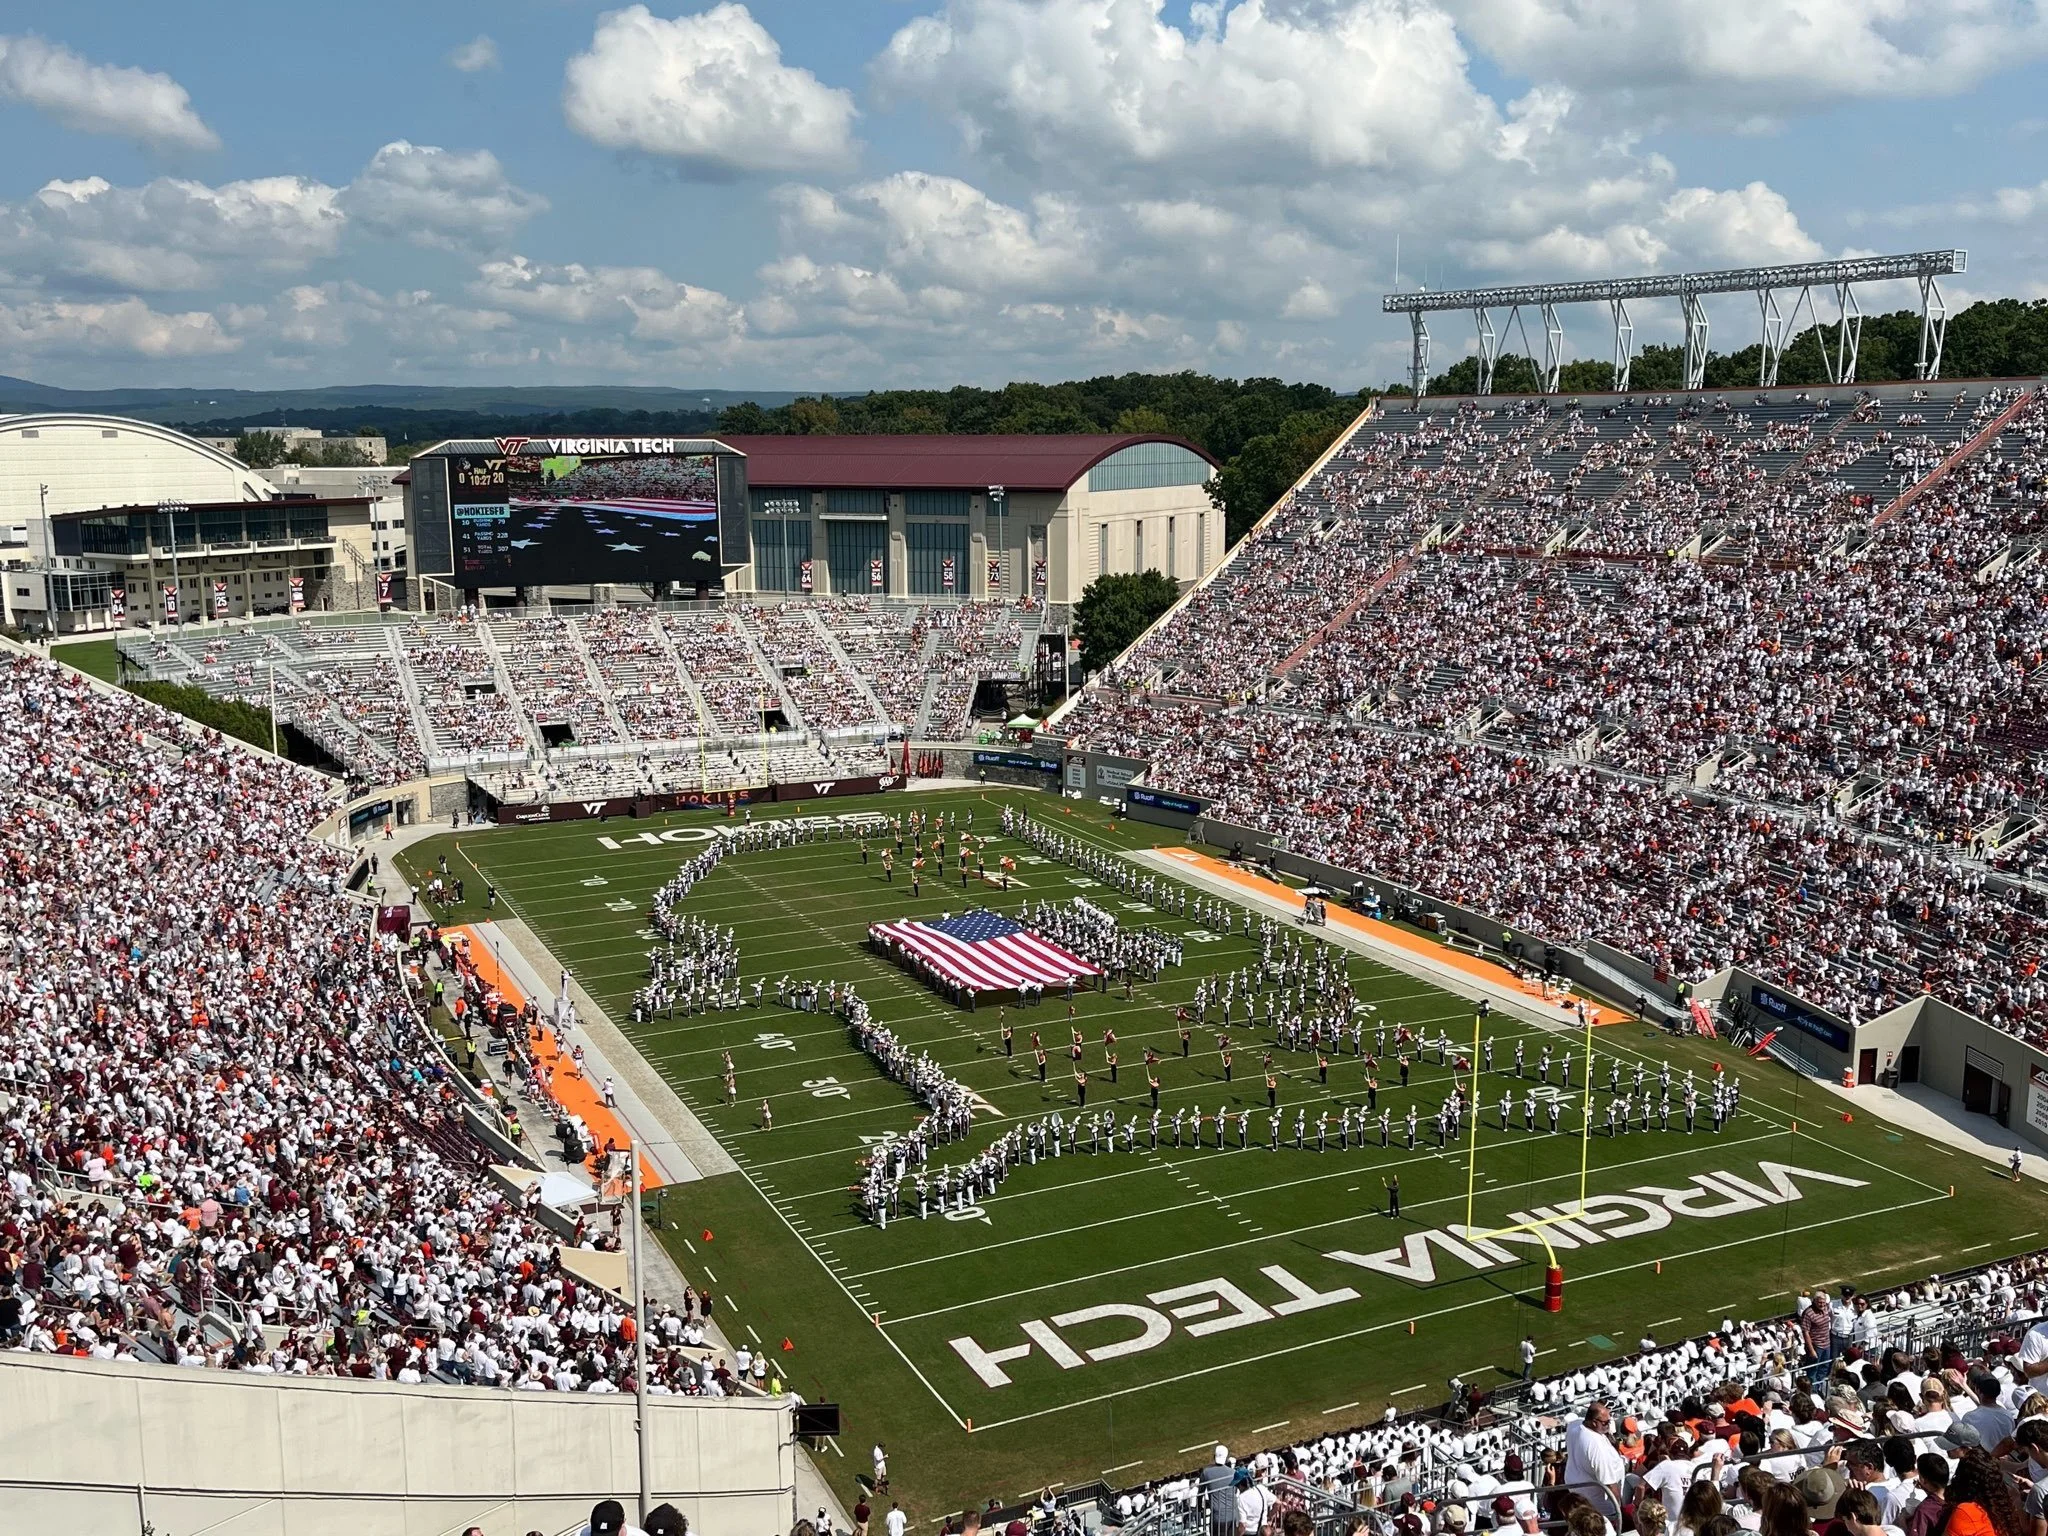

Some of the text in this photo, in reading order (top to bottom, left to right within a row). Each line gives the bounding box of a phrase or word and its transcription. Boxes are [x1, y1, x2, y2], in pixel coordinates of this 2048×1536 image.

[494, 437, 530, 455] VT
[547, 437, 674, 454] VIRGINIA TECH
[484, 459, 506, 470] VT
[473, 467, 487, 475] HALF
[458, 472, 504, 486] 0 10:27 20
[456, 506, 505, 516] @HOKIESFB
[801, 574, 812, 583] 64
[871, 572, 882, 581] 56
[943, 571, 953, 581] 58
[990, 572, 1000, 581] 73
[381, 587, 389, 597] 7
[167, 601, 176, 612] 10
[216, 596, 227, 607] 25
[1045, 761, 1058, 769] Ruoff
[813, 782, 836, 795] VT
[1140, 793, 1155, 802] Ruoff
[582, 801, 608, 814] VT
[1182, 930, 1223, 944] 50
[1768, 997, 1788, 1014] Ruoff
[753, 1033, 794, 1050] 40
[802, 1076, 849, 1098] 30
[1322, 1160, 1870, 1284] VIRGINIA
[947, 1263, 1363, 1388] TECH
